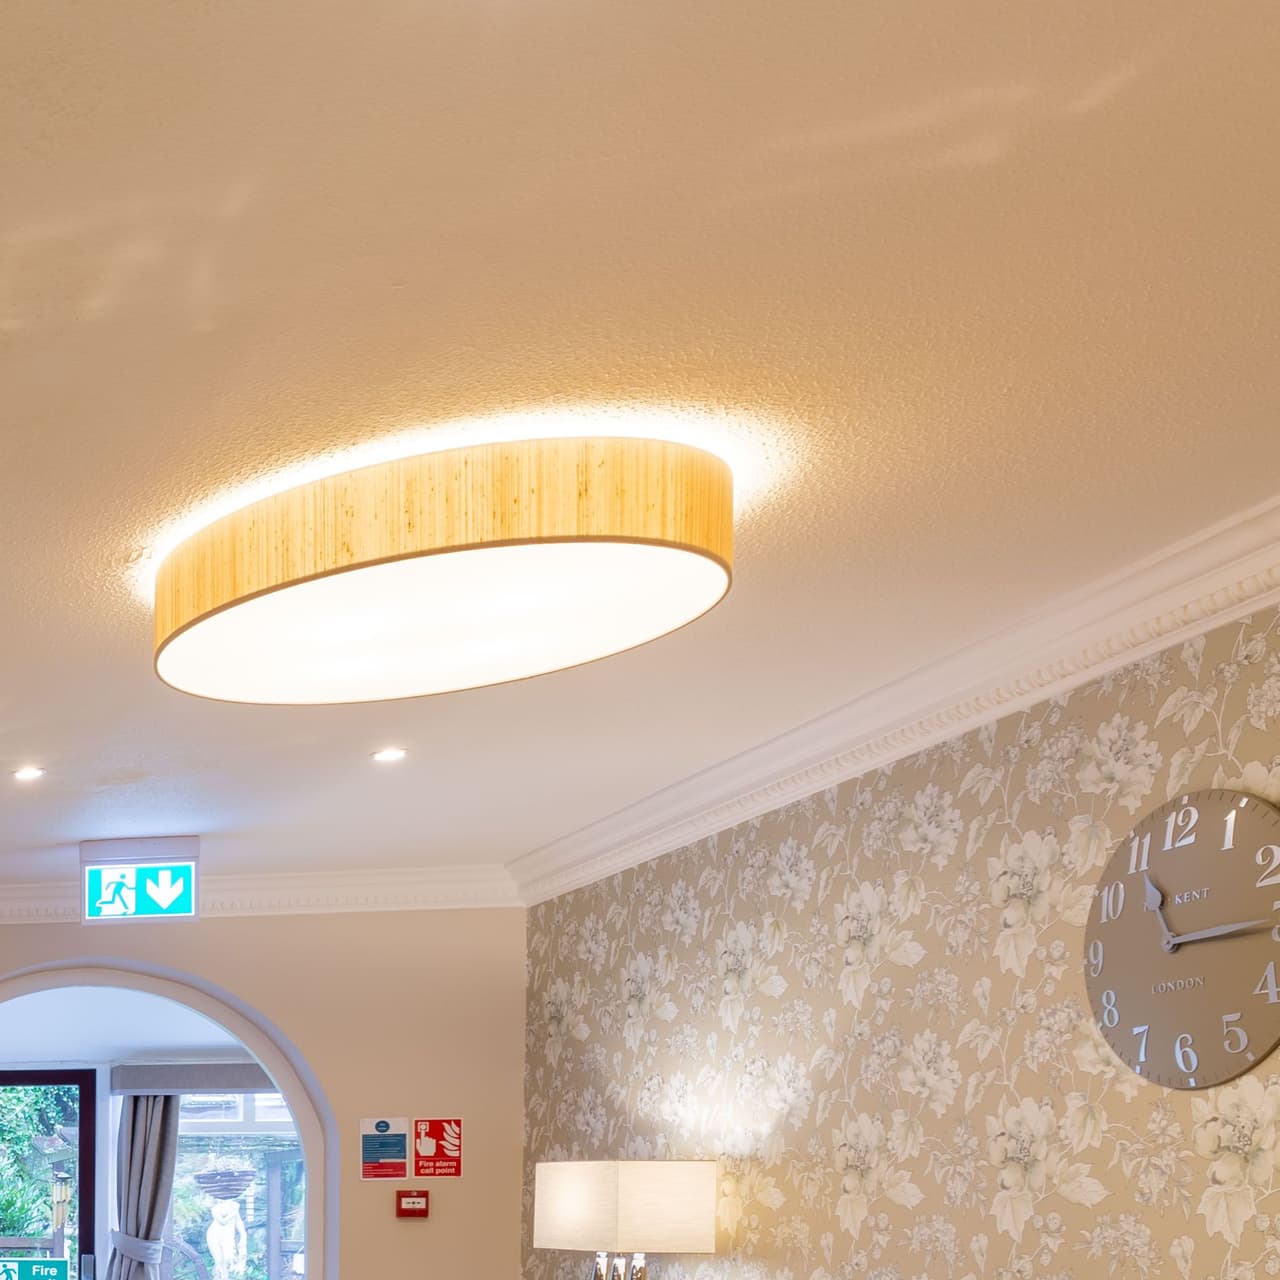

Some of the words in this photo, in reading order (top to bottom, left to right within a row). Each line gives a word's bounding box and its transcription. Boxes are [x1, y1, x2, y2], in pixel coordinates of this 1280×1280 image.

[1161, 806, 1200, 852] 12
[1221, 808, 1238, 851] 1
[1127, 831, 1152, 875] 11
[1255, 844, 1280, 889] 2
[1100, 880, 1126, 924] 10
[1174, 887, 1210, 905] KENT
[1088, 939, 1105, 978] 9
[1151, 976, 1206, 995] LONDON
[1252, 960, 1280, 1005] 4
[1102, 989, 1120, 1028] 8
[1131, 1023, 1150, 1063] 7
[1174, 1032, 1200, 1074] 6
[1222, 1011, 1249, 1054] 5
[32, 1265, 58, 1276] Fire
